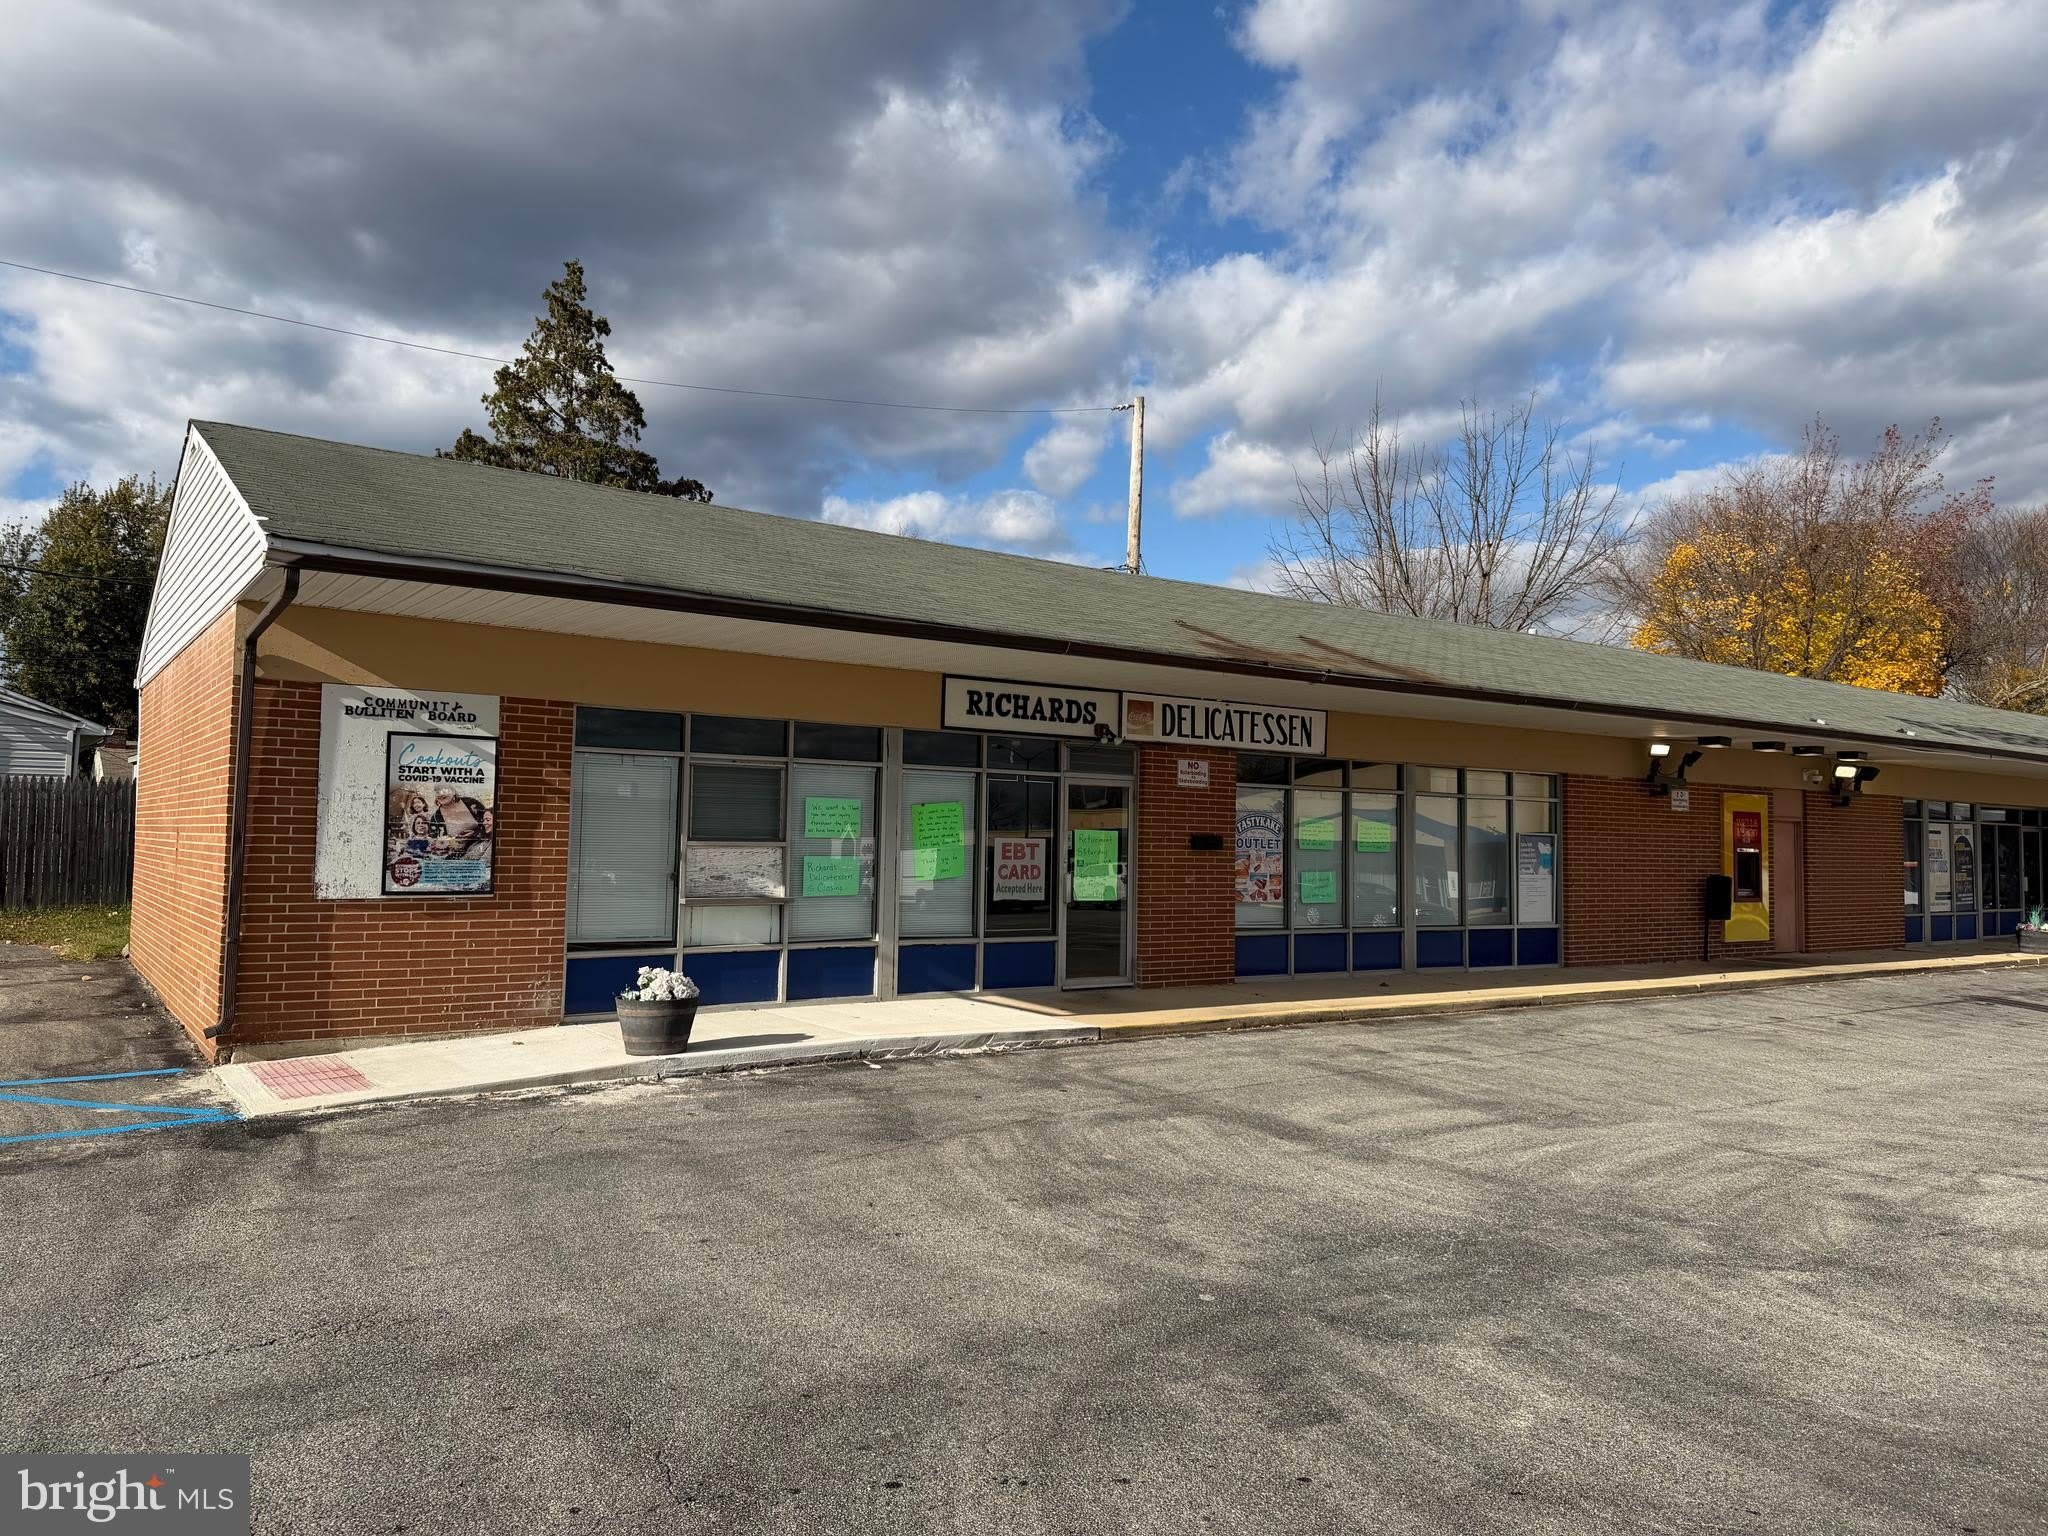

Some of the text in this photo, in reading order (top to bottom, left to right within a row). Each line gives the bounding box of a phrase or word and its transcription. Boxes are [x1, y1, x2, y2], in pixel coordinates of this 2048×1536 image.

[363, 696, 463, 712] COMMUNITY
[965, 689, 1098, 726] RICHARDS
[344, 705, 477, 723] BULLITEN BOARD
[1161, 703, 1313, 748] DELICATESSEN
[398, 742, 486, 768] Cookouts
[398, 765, 485, 777] START WITH A
[1187, 761, 1200, 770] NO
[398, 774, 485, 784] COVID-19 VACCINE
[1236, 816, 1281, 833] TASTYKAKE
[1001, 842, 1040, 861] EBT
[1236, 837, 1281, 850] OUTLET
[997, 864, 1041, 880] CARD
[996, 882, 1043, 896] Accepted Here
